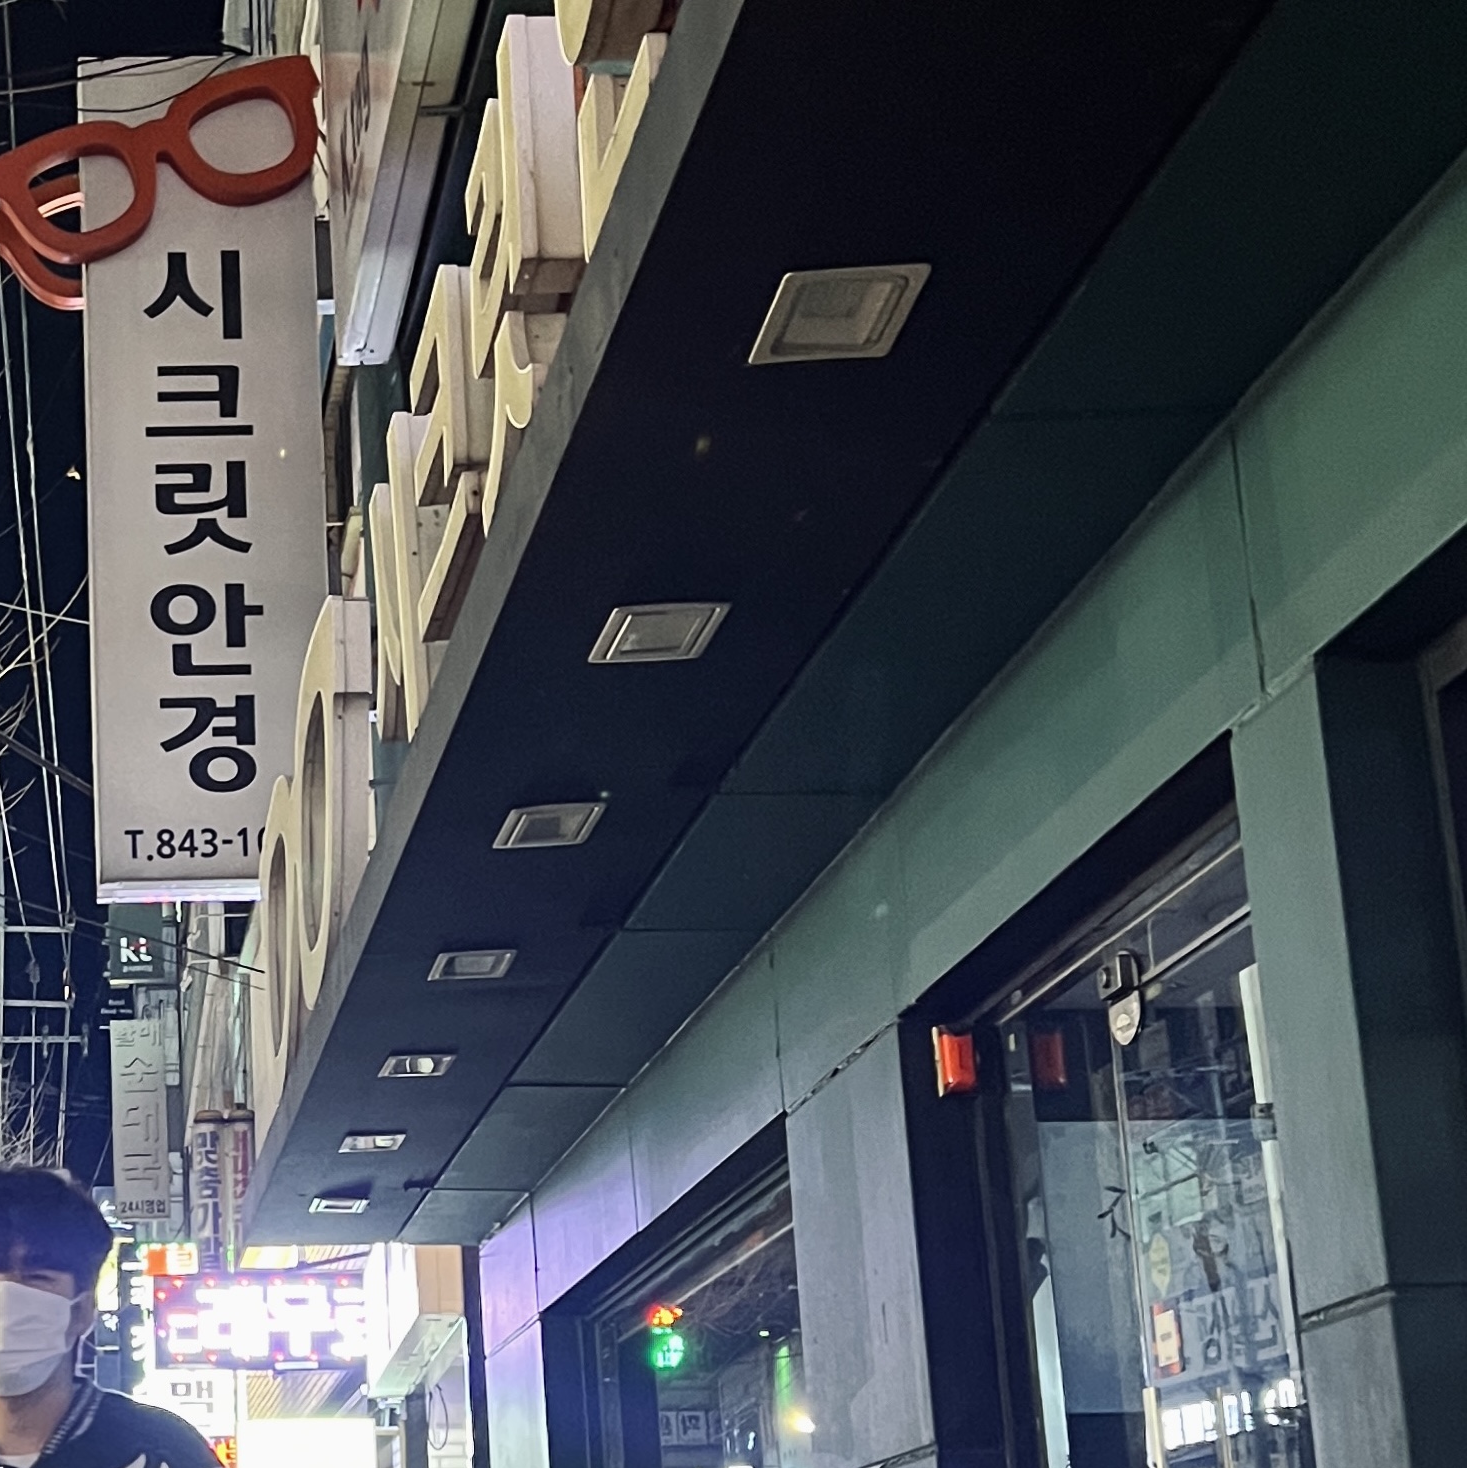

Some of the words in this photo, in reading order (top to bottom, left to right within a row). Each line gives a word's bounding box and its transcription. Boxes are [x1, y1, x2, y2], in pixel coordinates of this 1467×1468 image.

[143, 249, 264, 794] 시크릿안경
[119, 936, 153, 963] kt
[119, 1056, 163, 1194] 순대국
